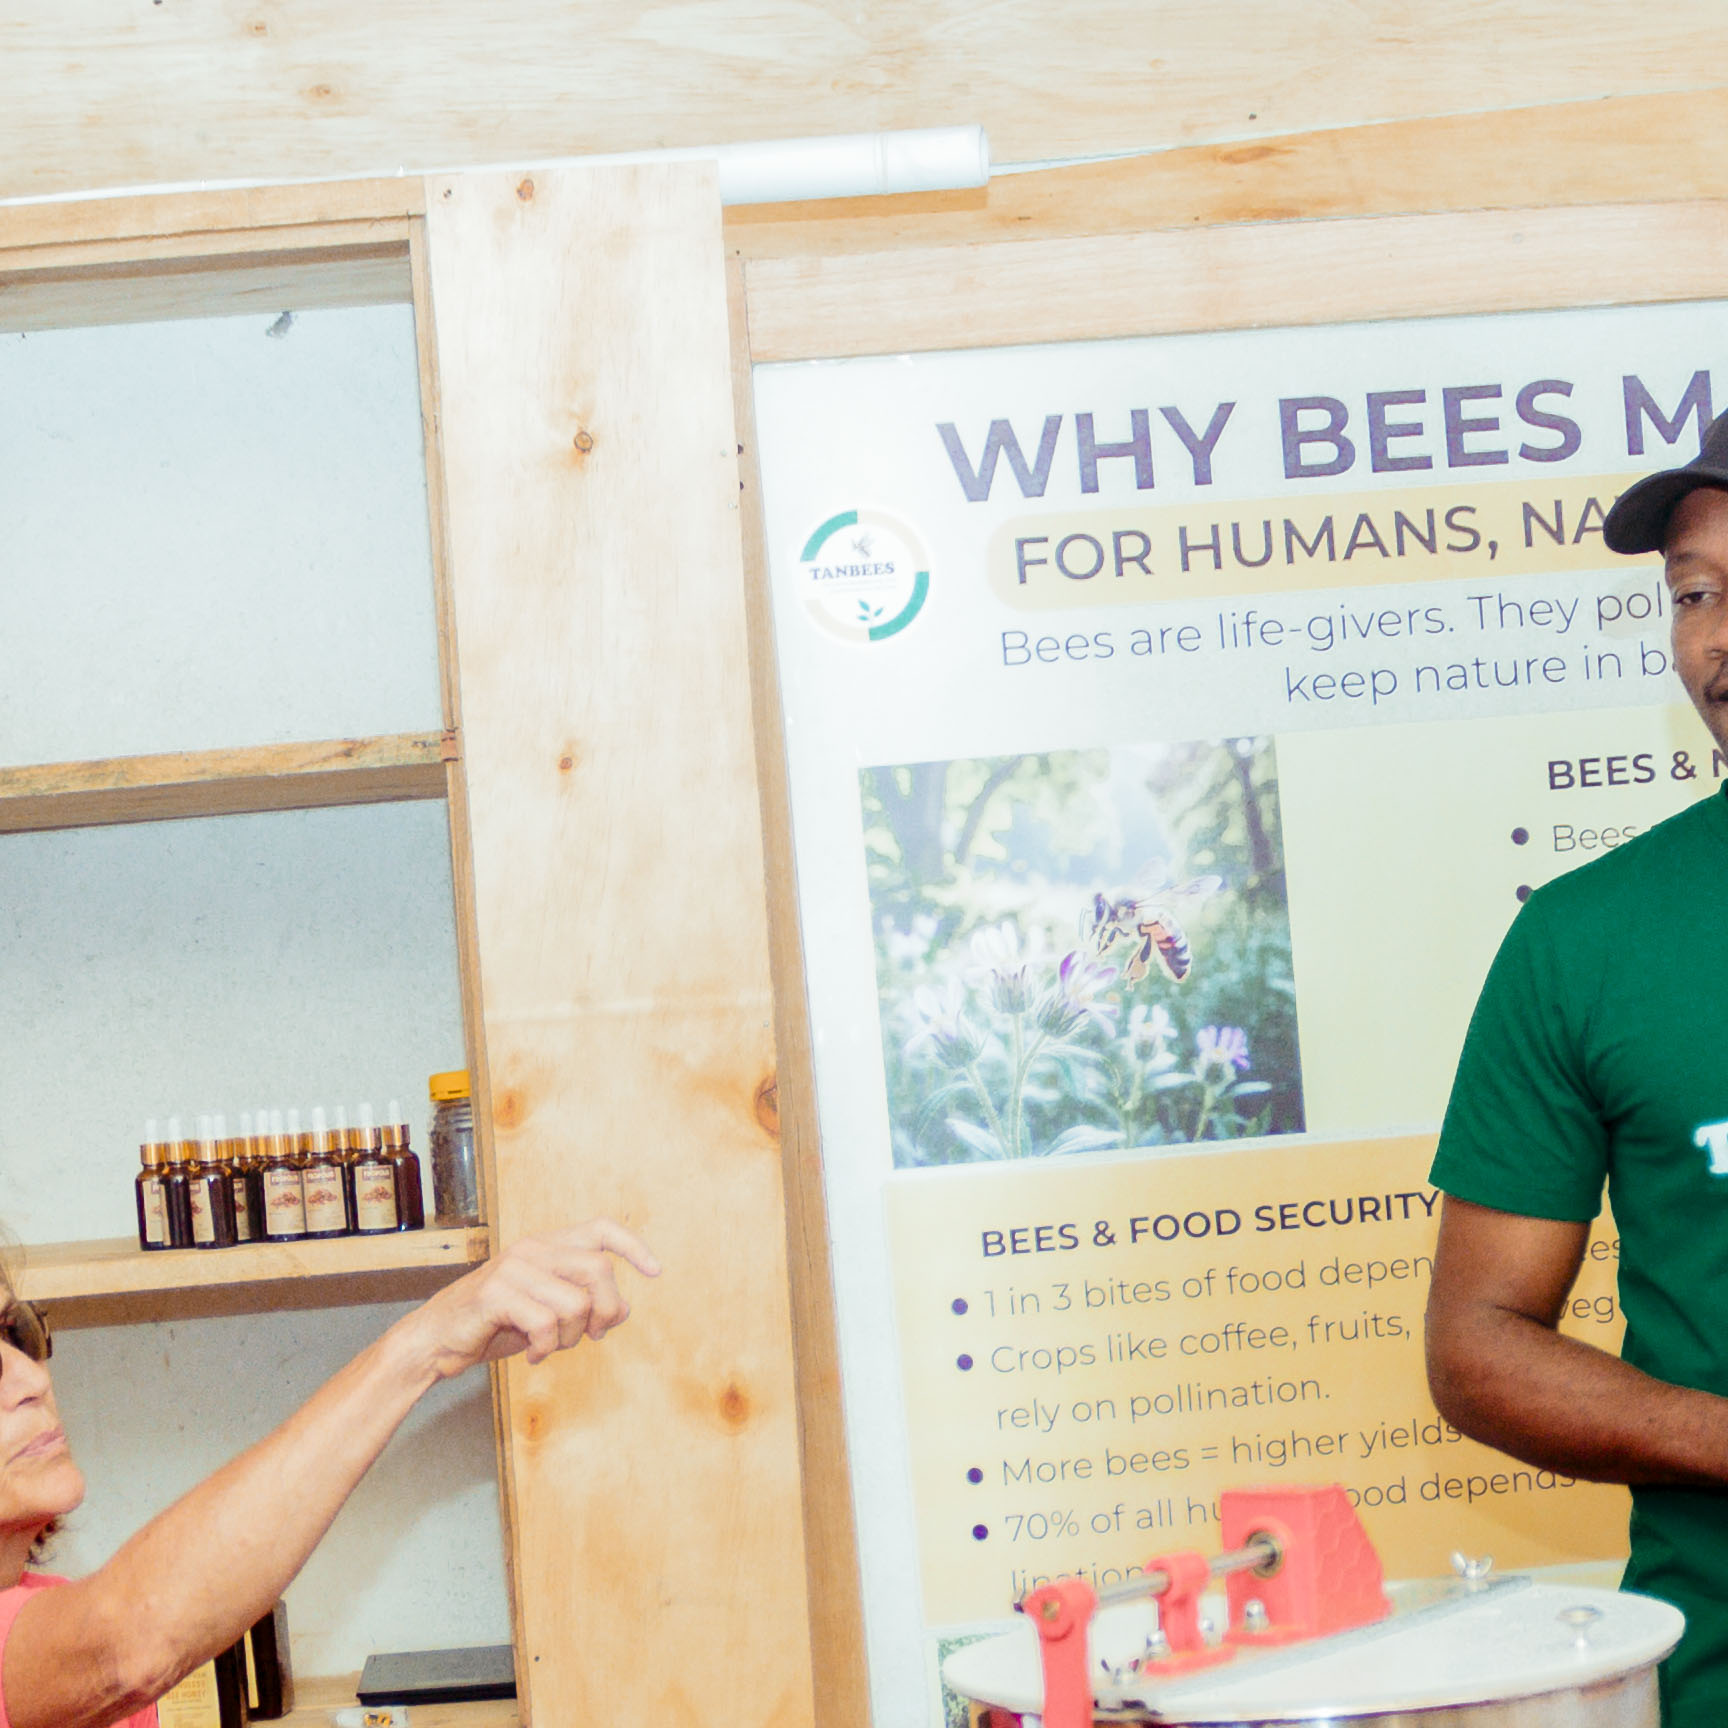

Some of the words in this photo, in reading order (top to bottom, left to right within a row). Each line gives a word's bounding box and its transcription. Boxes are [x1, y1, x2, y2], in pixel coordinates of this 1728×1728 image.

[934, 400, 1237, 503] WHY
[1277, 378, 1583, 480] BEES
[809, 561, 896, 582] TANBEES
[1014, 529, 1155, 585] FOR
[1178, 504, 1499, 572] HUMANS,
[1001, 628, 1116, 667] Bees
[1130, 625, 1202, 656] are
[1218, 603, 1455, 652] life-givers.
[1466, 593, 1578, 641] They
[1285, 666, 1399, 706] keep
[1414, 655, 1568, 695] nature
[1582, 644, 1622, 681] in
[1547, 752, 1656, 790] BEES
[1669, 749, 1697, 781] &
[1552, 824, 1638, 853] Bees
[980, 1222, 1080, 1258] BEES
[1091, 1220, 1116, 1248] &
[1128, 1208, 1242, 1245] FOOD
[1253, 1189, 1441, 1233] SECURITY
[983, 1290, 996, 1318] 1
[1007, 1286, 1040, 1315] in
[1051, 1282, 1072, 1312] 3
[1083, 1277, 1171, 1309] bites
[1181, 1267, 1217, 1299] of
[1226, 1259, 1307, 1295] food
[1319, 1256, 1434, 1289] depen
[990, 1342, 1096, 1375] Crops
[1106, 1331, 1168, 1364] like
[1179, 1321, 1298, 1356] coffee,
[1307, 1310, 1411, 1344] fruits,
[996, 1398, 1061, 1433] rely
[1071, 1398, 1116, 1424] on
[1129, 1375, 1331, 1425] pollination.
[1002, 1457, 1093, 1486] More
[1104, 1448, 1190, 1477] bees
[1200, 1445, 1219, 1461] =
[1231, 1428, 1350, 1468] higher
[1359, 1416, 1462, 1459] yields
[1004, 1509, 1080, 1542] 70%
[1090, 1502, 1125, 1534] of
[1135, 1498, 1173, 1530] all
[1345, 1475, 1407, 1508] ood
